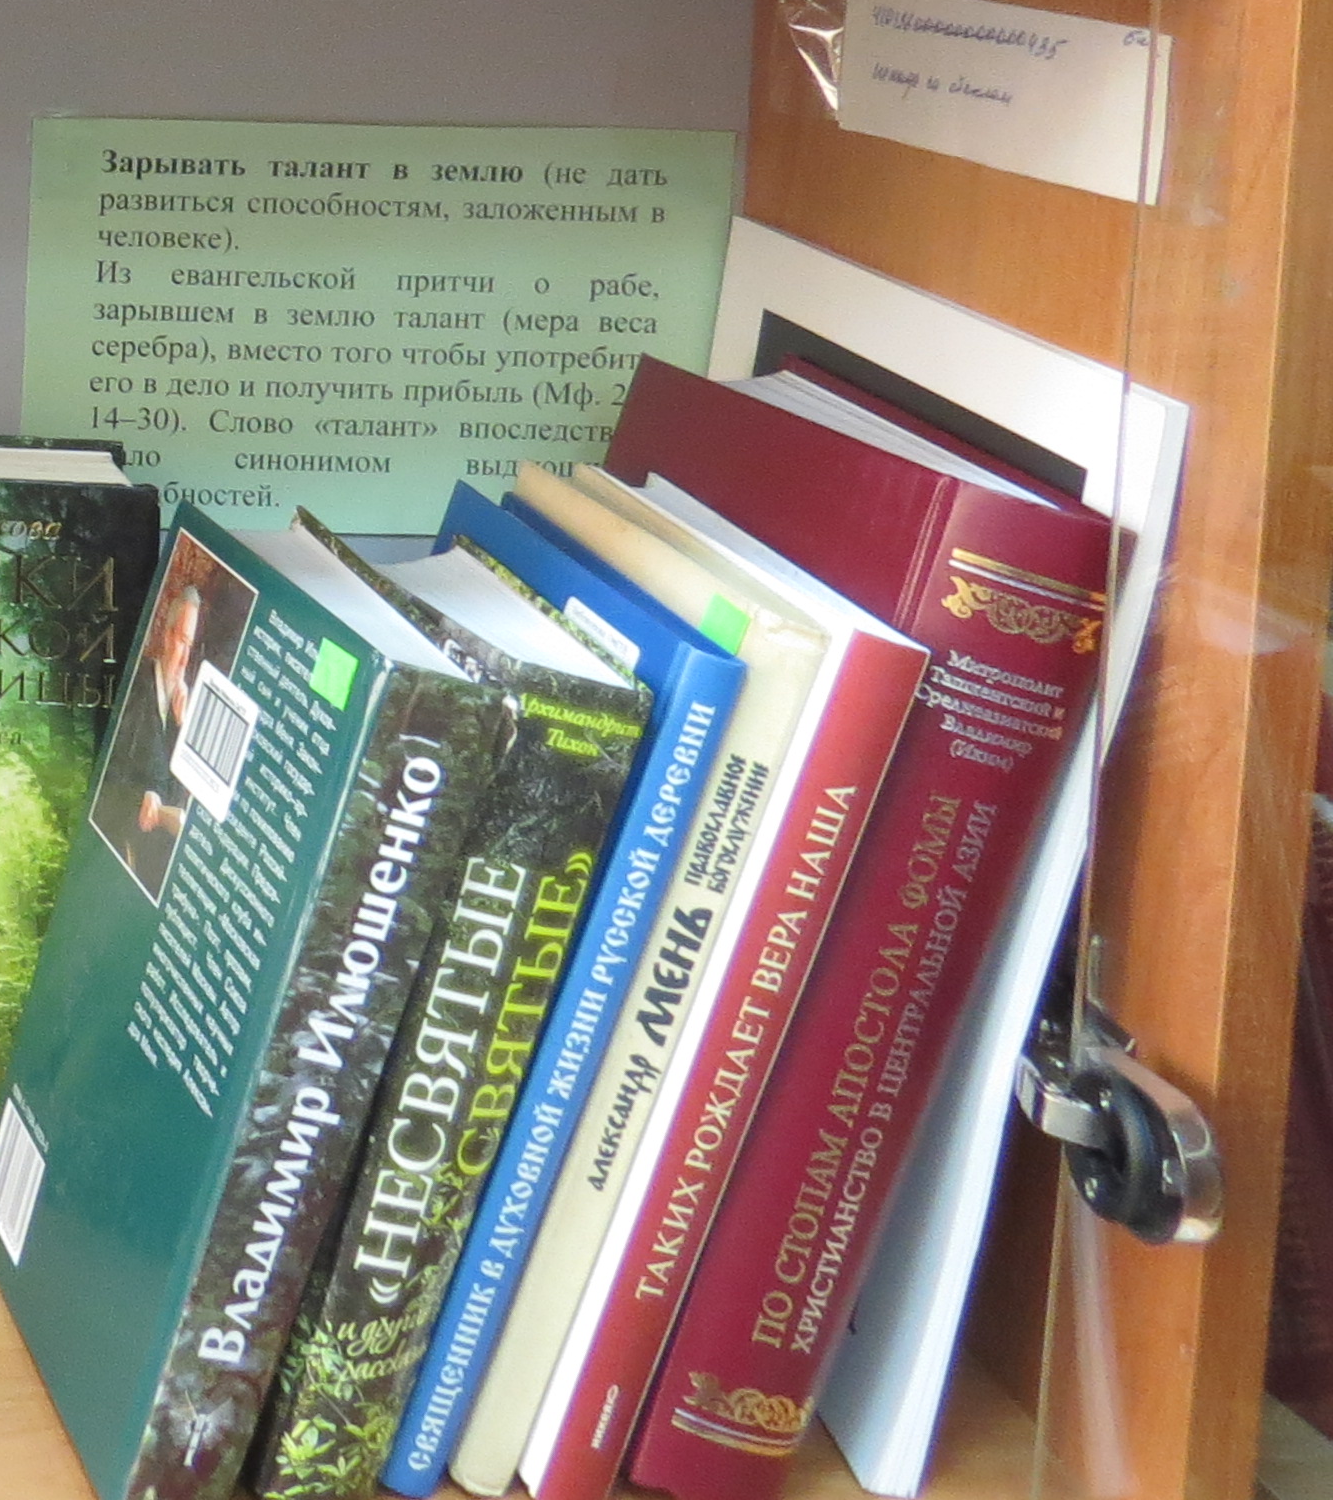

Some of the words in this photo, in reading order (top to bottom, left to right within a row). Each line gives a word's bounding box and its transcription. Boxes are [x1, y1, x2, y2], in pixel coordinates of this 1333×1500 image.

[98, 227, 239, 253] человеке).
[99, 192, 234, 217] развиться
[247, 195, 450, 222] способностям,
[463, 201, 637, 225] заложенным
[651, 207, 665, 224] в
[102, 150, 245, 180] Зарывать
[269, 157, 370, 181] талант
[393, 163, 409, 181] в
[431, 162, 523, 183] землю
[544, 163, 586, 188] (не
[606, 165, 667, 189] дать
[96, 262, 131, 285] Из
[171, 267, 355, 295] евангельской
[397, 272, 495, 297] притчи
[534, 277, 550, 295] о
[589, 272, 659, 303] рабе,
[655, 701, 716, 848] ДЕРЕВНИ
[684, 754, 747, 887] ПРАВОСЛАВНОЕ
[707, 762, 770, 894] БОГОСЛУЖЕНИЕ
[954, 800, 998, 882] АЗИИ
[591, 850, 660, 986] РУССКОЙ
[196, 1084, 344, 1368] Владимир
[303, 753, 447, 1070] Илюшенко
[454, 850, 598, 1178] СВЯТЫЕ»
[548, 991, 608, 1100] ЖИЗНИ
[587, 1053, 662, 1191] АЛЕКСАНДР
[636, 906, 714, 1048] МЕНЬ
[636, 1177, 706, 1300] ТАКИХ
[685, 996, 774, 1173] РОЖДАЕТ
[751, 908, 809, 993] ВЕРА
[786, 784, 858, 902] НАША
[877, 884, 968, 1097] ЦЕНТРАЛЬНОЙ
[356, 855, 529, 1307] «НЕСВЯТЫЕ
[751, 1289, 793, 1350] ПО
[775, 1128, 847, 1284] СТОПАМ
[831, 920, 919, 1128] АПОСТОЛА
[902, 794, 963, 910] ФОМЫ
[869, 1103, 893, 1121] В
[489, 1103, 563, 1259] ДУХОВНОЙ
[791, 1127, 883, 1354] ХРИСТИАНСТВО
[480, 1259, 505, 1282] В
[407, 1283, 495, 1471] СВЯЩЕННИК
